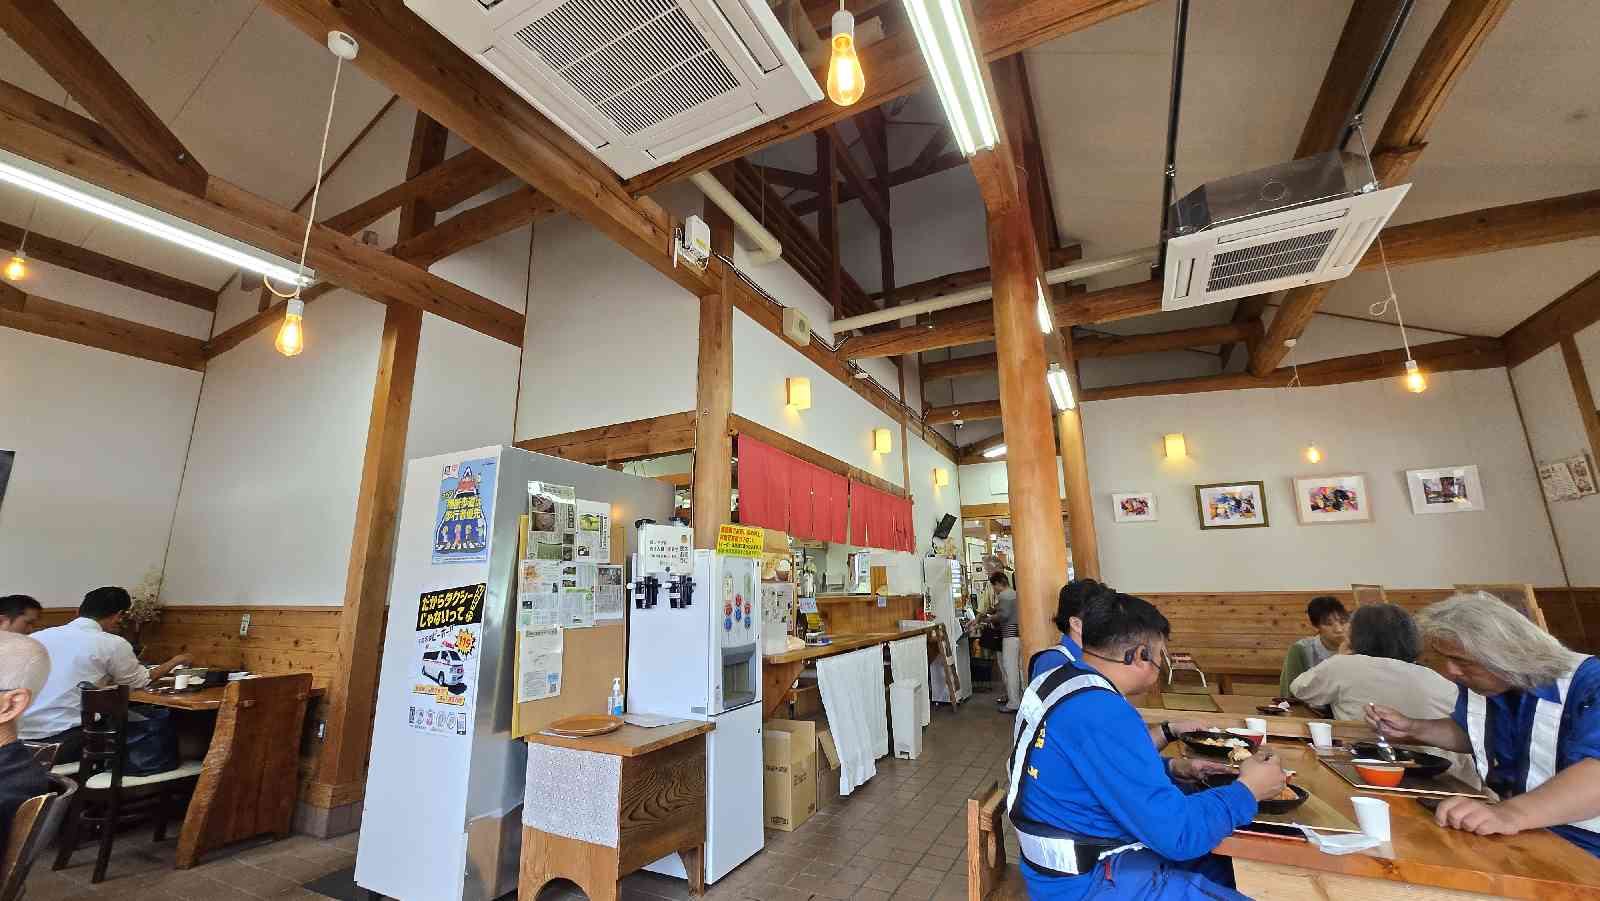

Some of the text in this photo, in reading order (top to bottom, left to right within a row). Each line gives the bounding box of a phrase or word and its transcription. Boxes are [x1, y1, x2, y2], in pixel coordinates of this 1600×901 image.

[421, 590, 473, 611] だからタクシー
